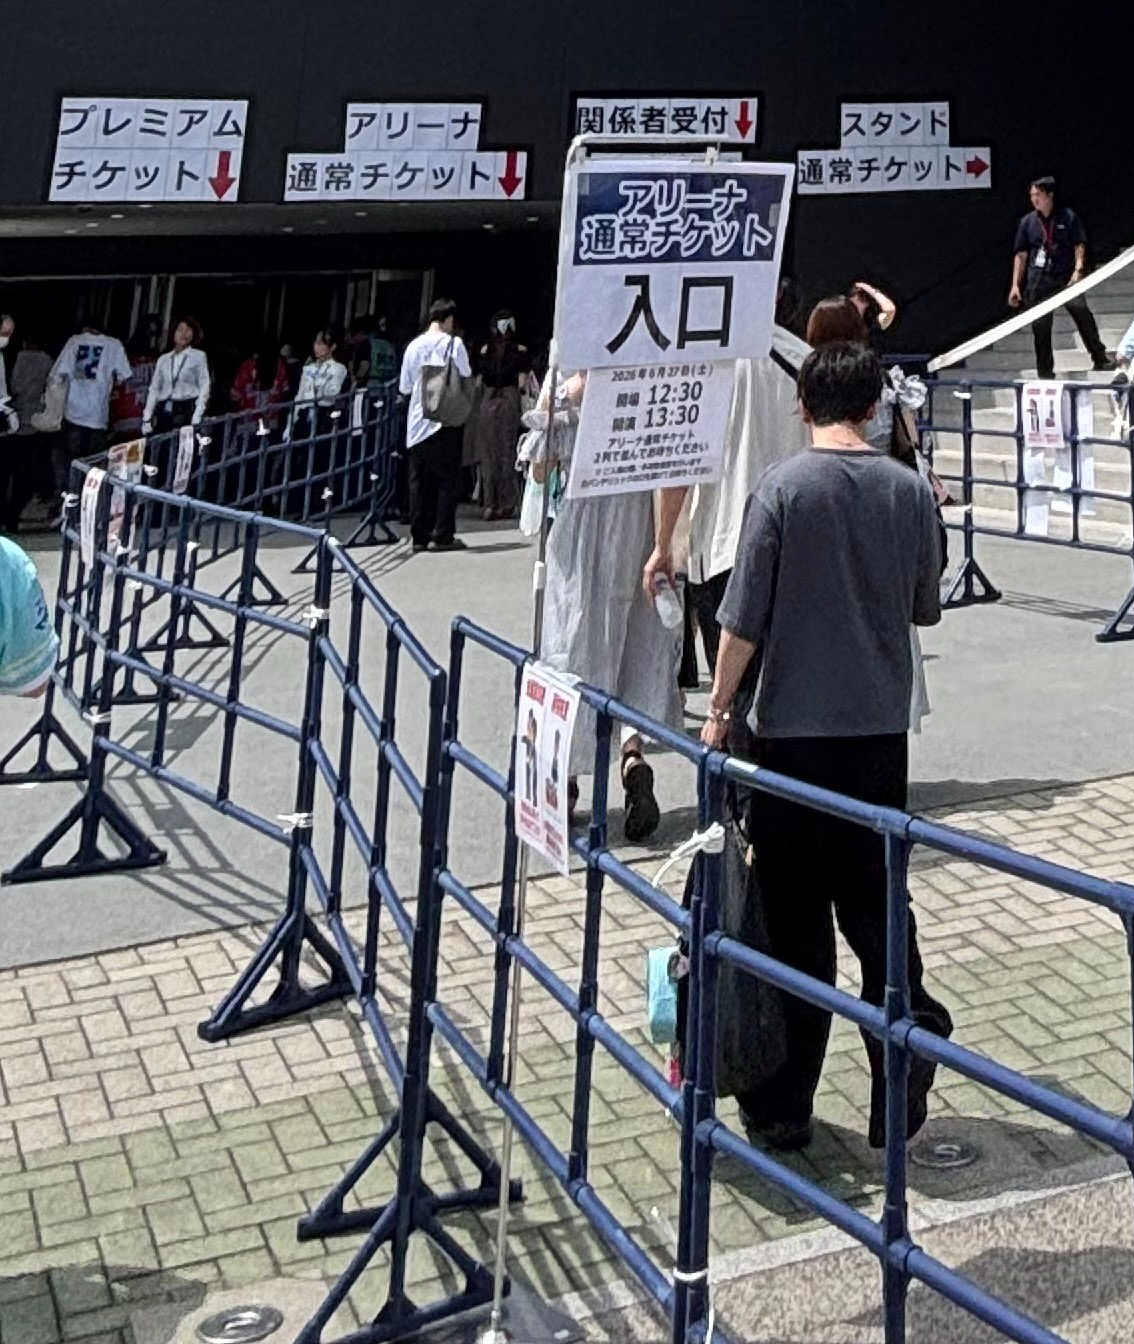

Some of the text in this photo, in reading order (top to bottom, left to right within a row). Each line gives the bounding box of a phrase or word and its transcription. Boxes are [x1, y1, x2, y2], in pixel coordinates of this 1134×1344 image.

[59, 104, 244, 138] プレミアム
[347, 111, 480, 140] アリーナ
[577, 105, 729, 135] 関係者受付
[843, 110, 948, 137] スタンド
[53, 159, 201, 191] チケット
[287, 161, 492, 192] 通常チケット
[800, 156, 963, 185] 通常チケット
[618, 179, 747, 218] アリーナ
[579, 215, 773, 260] 通常チケット
[605, 274, 735, 356] 入口
[647, 381, 704, 405] 12:30
[643, 404, 700, 429] 13:30
